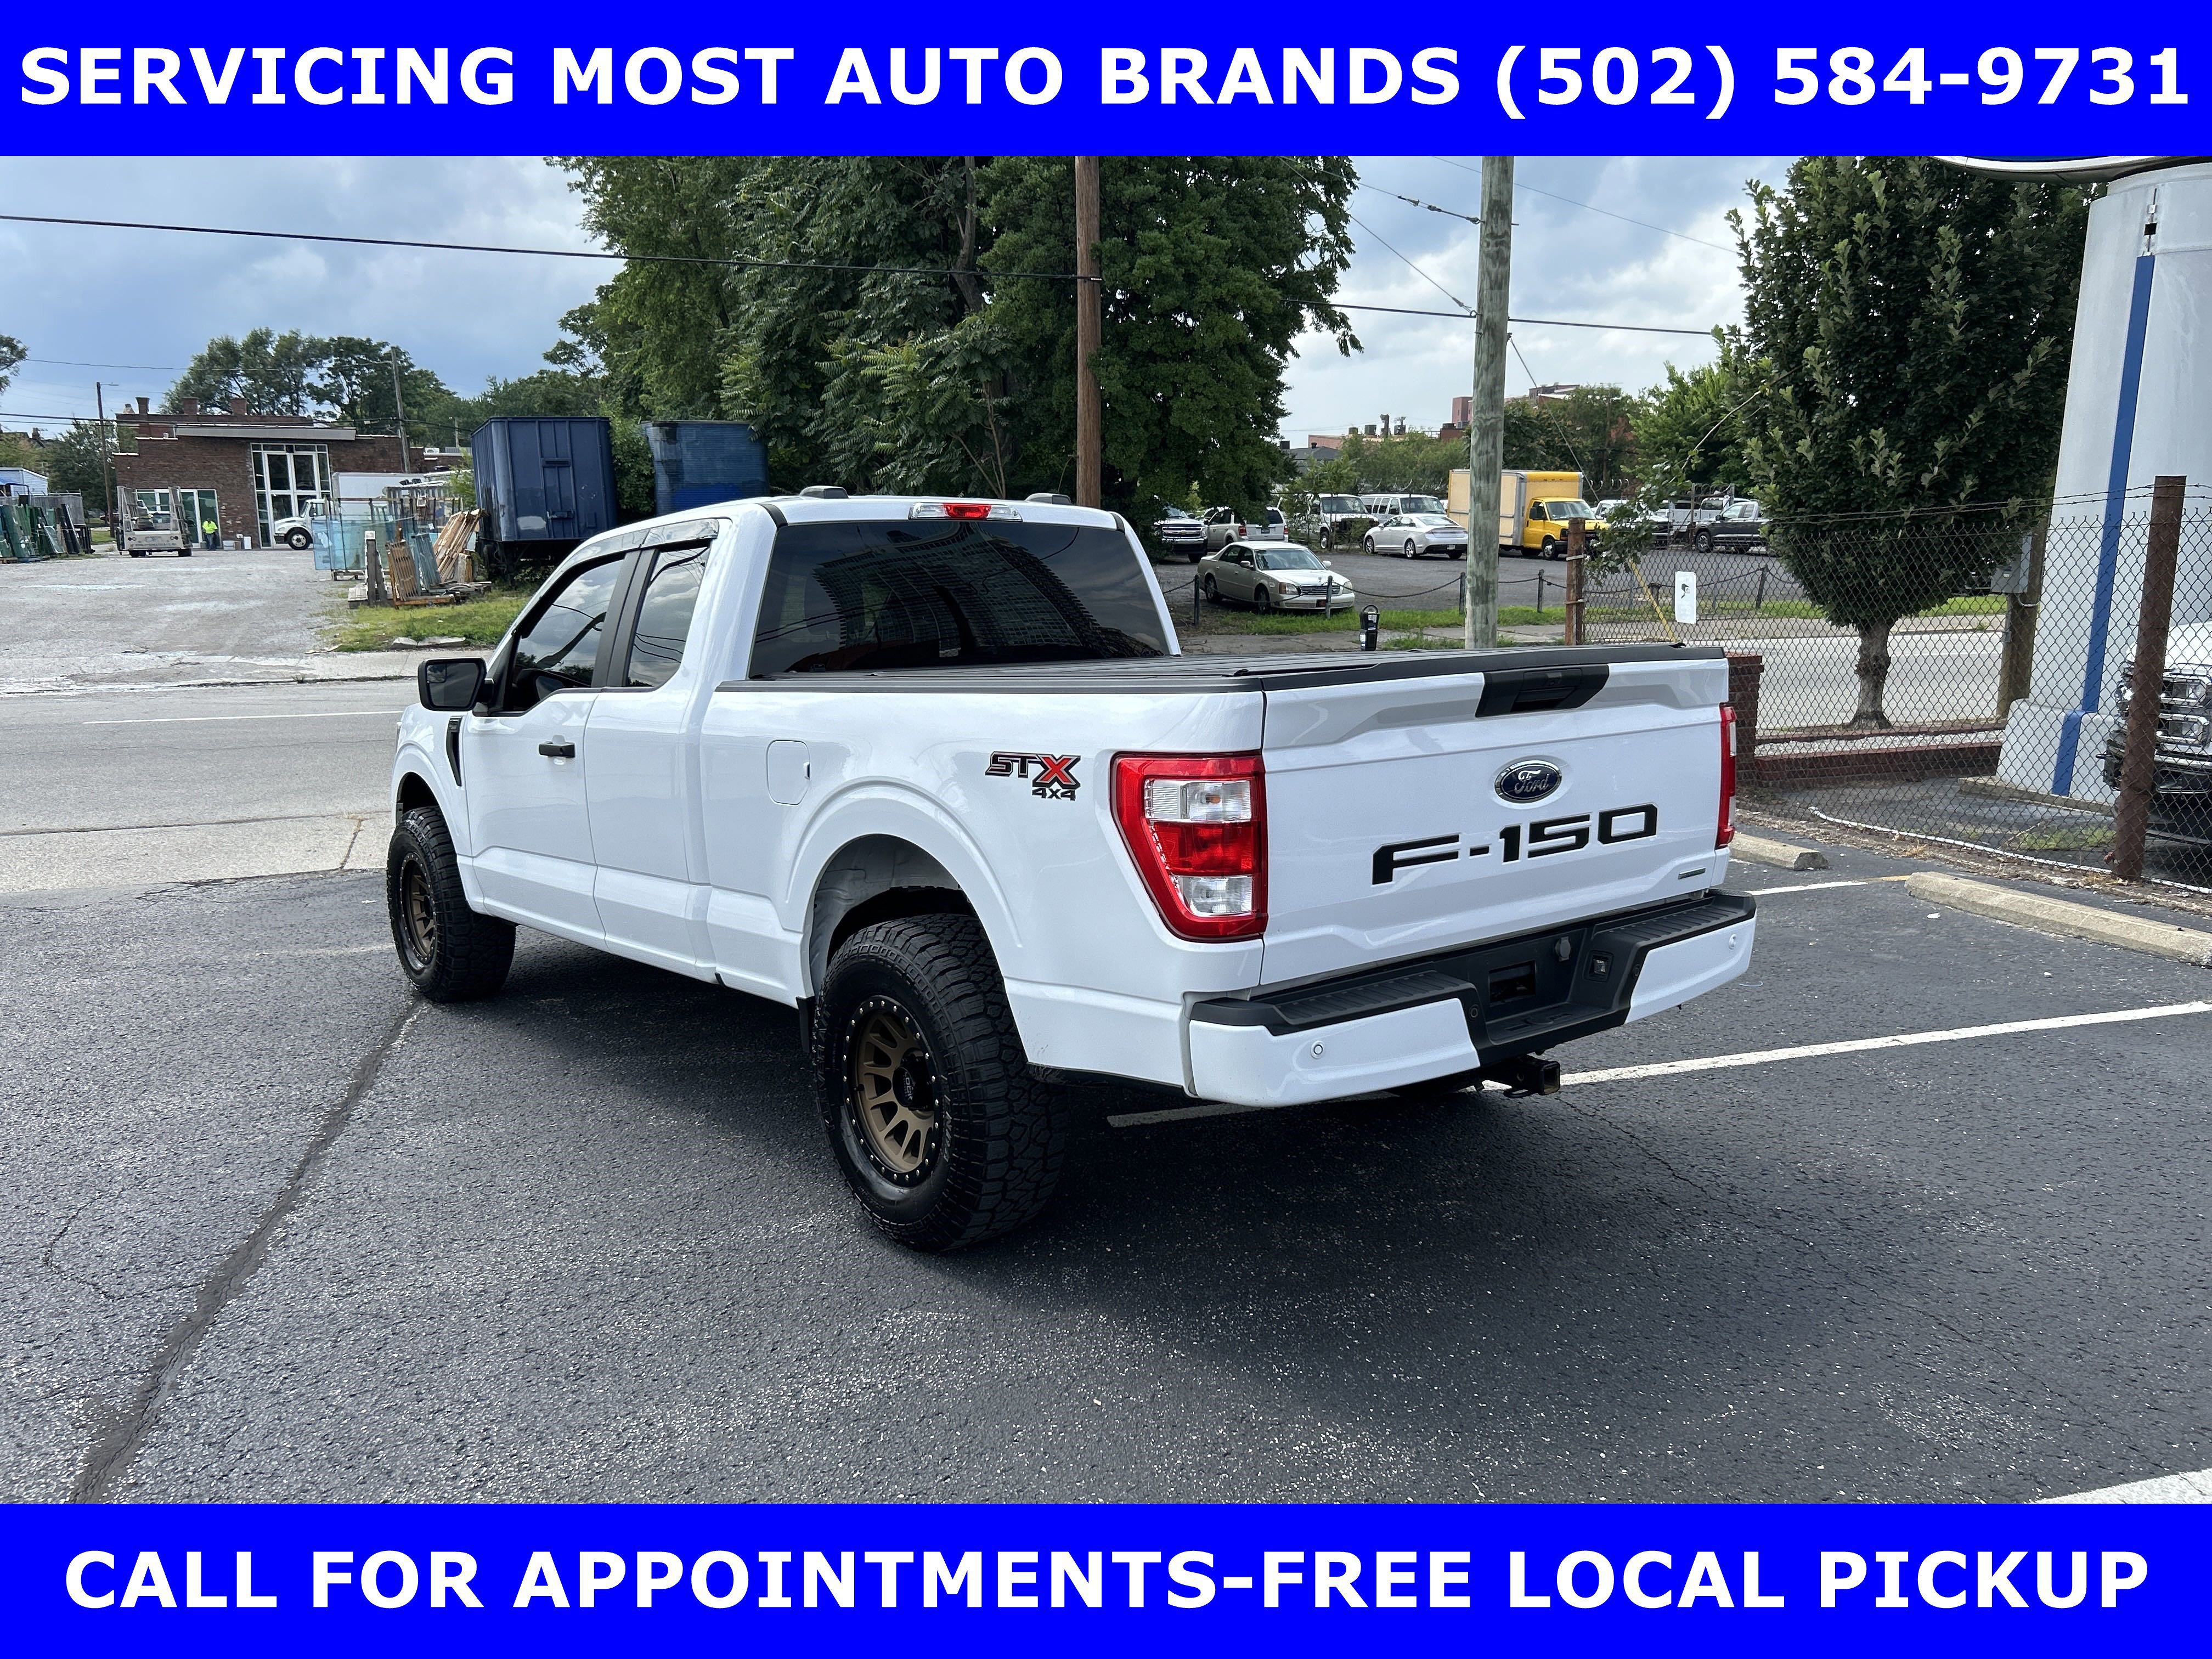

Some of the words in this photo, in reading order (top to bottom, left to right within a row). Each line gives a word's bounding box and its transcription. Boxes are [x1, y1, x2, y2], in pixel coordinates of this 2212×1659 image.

[985, 751, 1081, 789] STX
[1514, 769, 1550, 794] Ford
[1372, 803, 1658, 885] F-150
